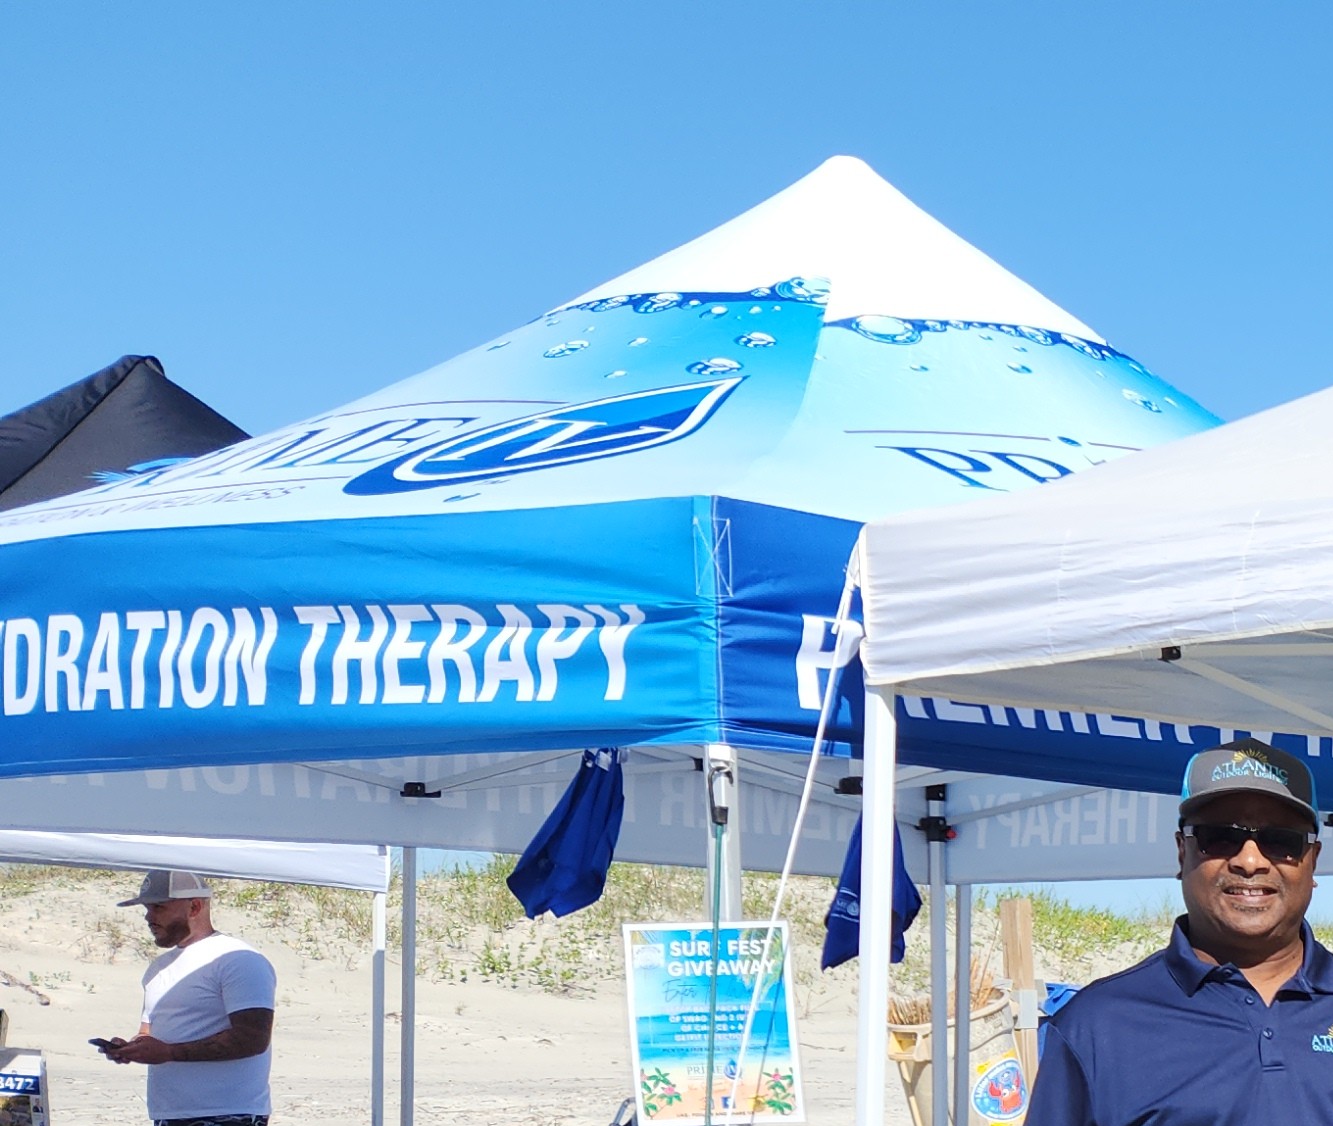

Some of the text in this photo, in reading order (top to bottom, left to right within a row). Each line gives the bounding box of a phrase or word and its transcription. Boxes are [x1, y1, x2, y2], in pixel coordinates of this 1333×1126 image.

[0, 603, 646, 716] DRATION THERAPY
[1212, 758, 1289, 781] ATLANTIC
[727, 939, 771, 957] FEST
[686, 1064, 723, 1076] PRIE
